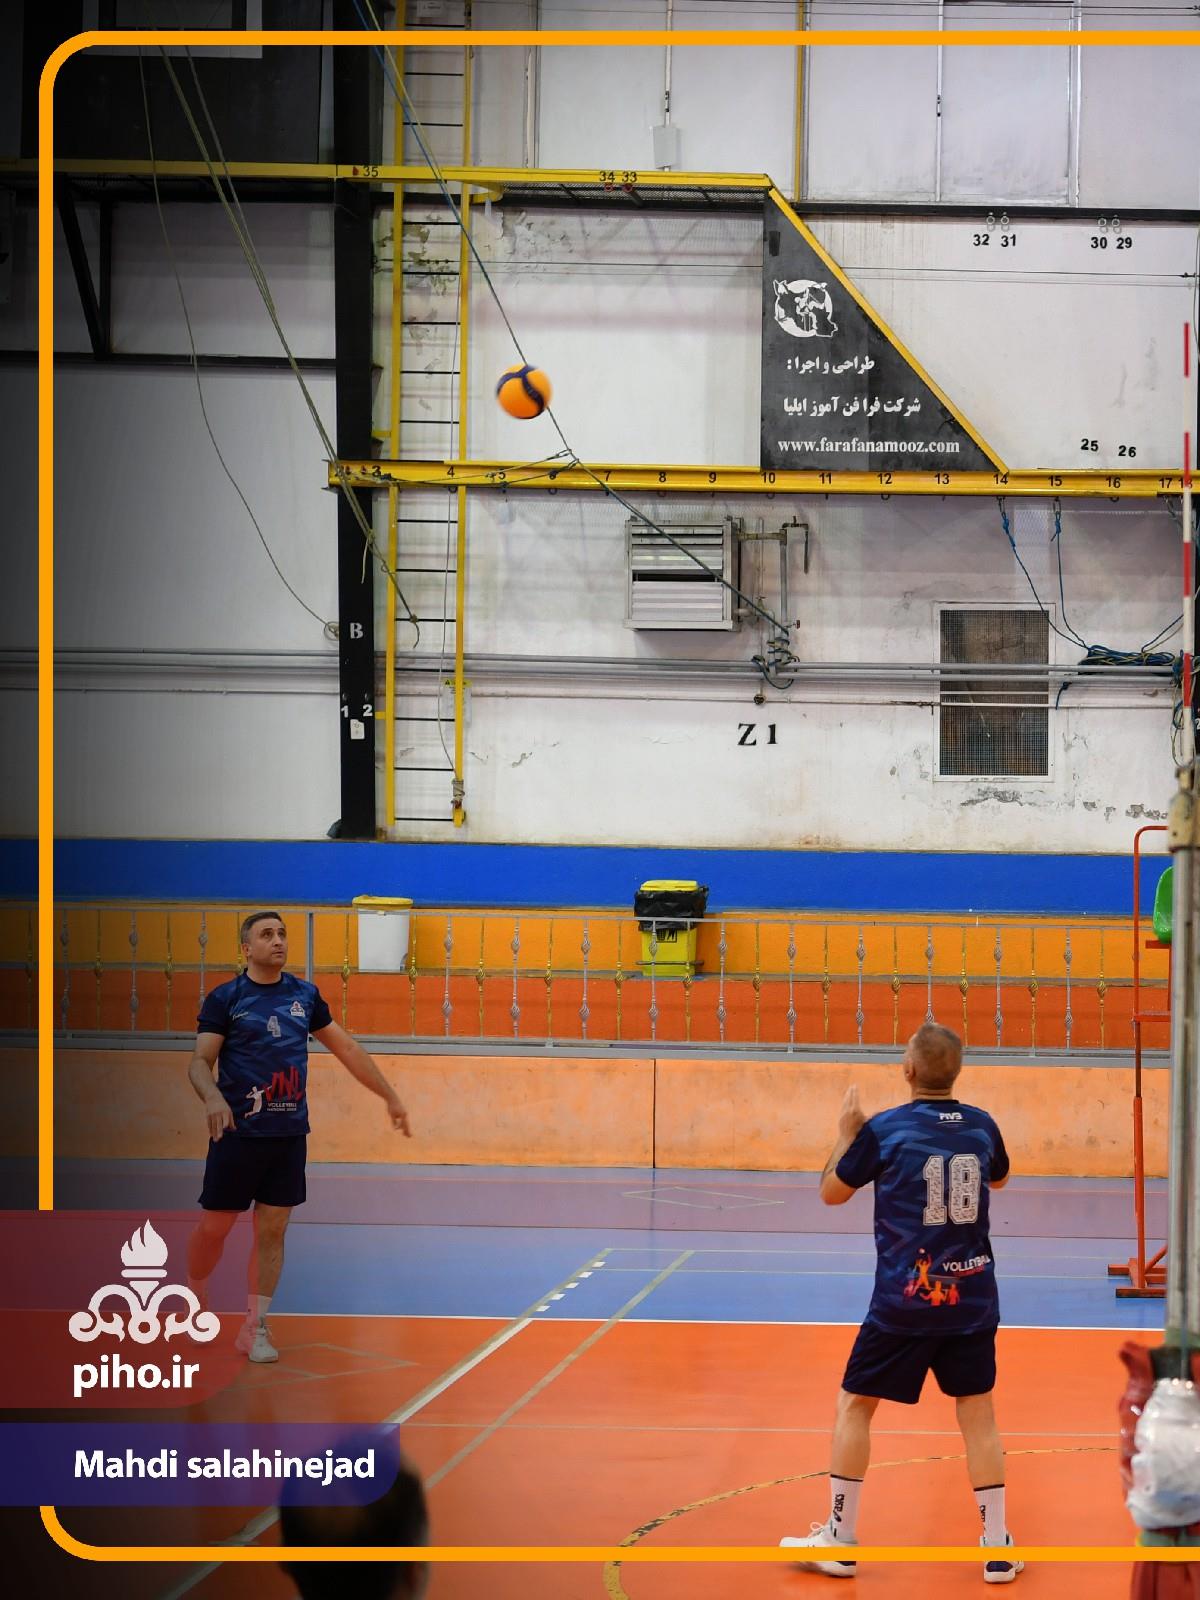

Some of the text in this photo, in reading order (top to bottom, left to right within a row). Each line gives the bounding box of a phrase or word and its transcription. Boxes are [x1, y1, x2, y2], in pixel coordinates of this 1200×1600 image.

[363, 165, 379, 178] 35
[599, 171, 638, 183] 34 33
[973, 233, 1017, 248] 32 31
[1090, 236, 1133, 250] 30 29
[822, 361, 830, 374] و
[832, 355, 875, 375] طراحی
[783, 396, 922, 417] شرکت فرا فن آموز ایلیا
[777, 436, 960, 454] www.farafanamooz.com
[1080, 438, 1137, 458] 25 26
[446, 466, 456, 478] 4
[604, 470, 612, 482] 7
[658, 471, 667, 483] 8
[708, 472, 717, 483] 9
[761, 472, 776, 484] 10
[818, 472, 832, 485] 11
[877, 473, 893, 485] 12
[934, 473, 950, 485] 13
[993, 473, 1009, 485] 14
[1049, 475, 1063, 488] 15
[1105, 476, 1121, 489] 16
[1158, 477, 1173, 489] 17
[349, 622, 364, 639] B
[340, 704, 373, 718] 1 2
[266, 1015, 282, 1038] 4
[922, 1154, 981, 1226] 18
